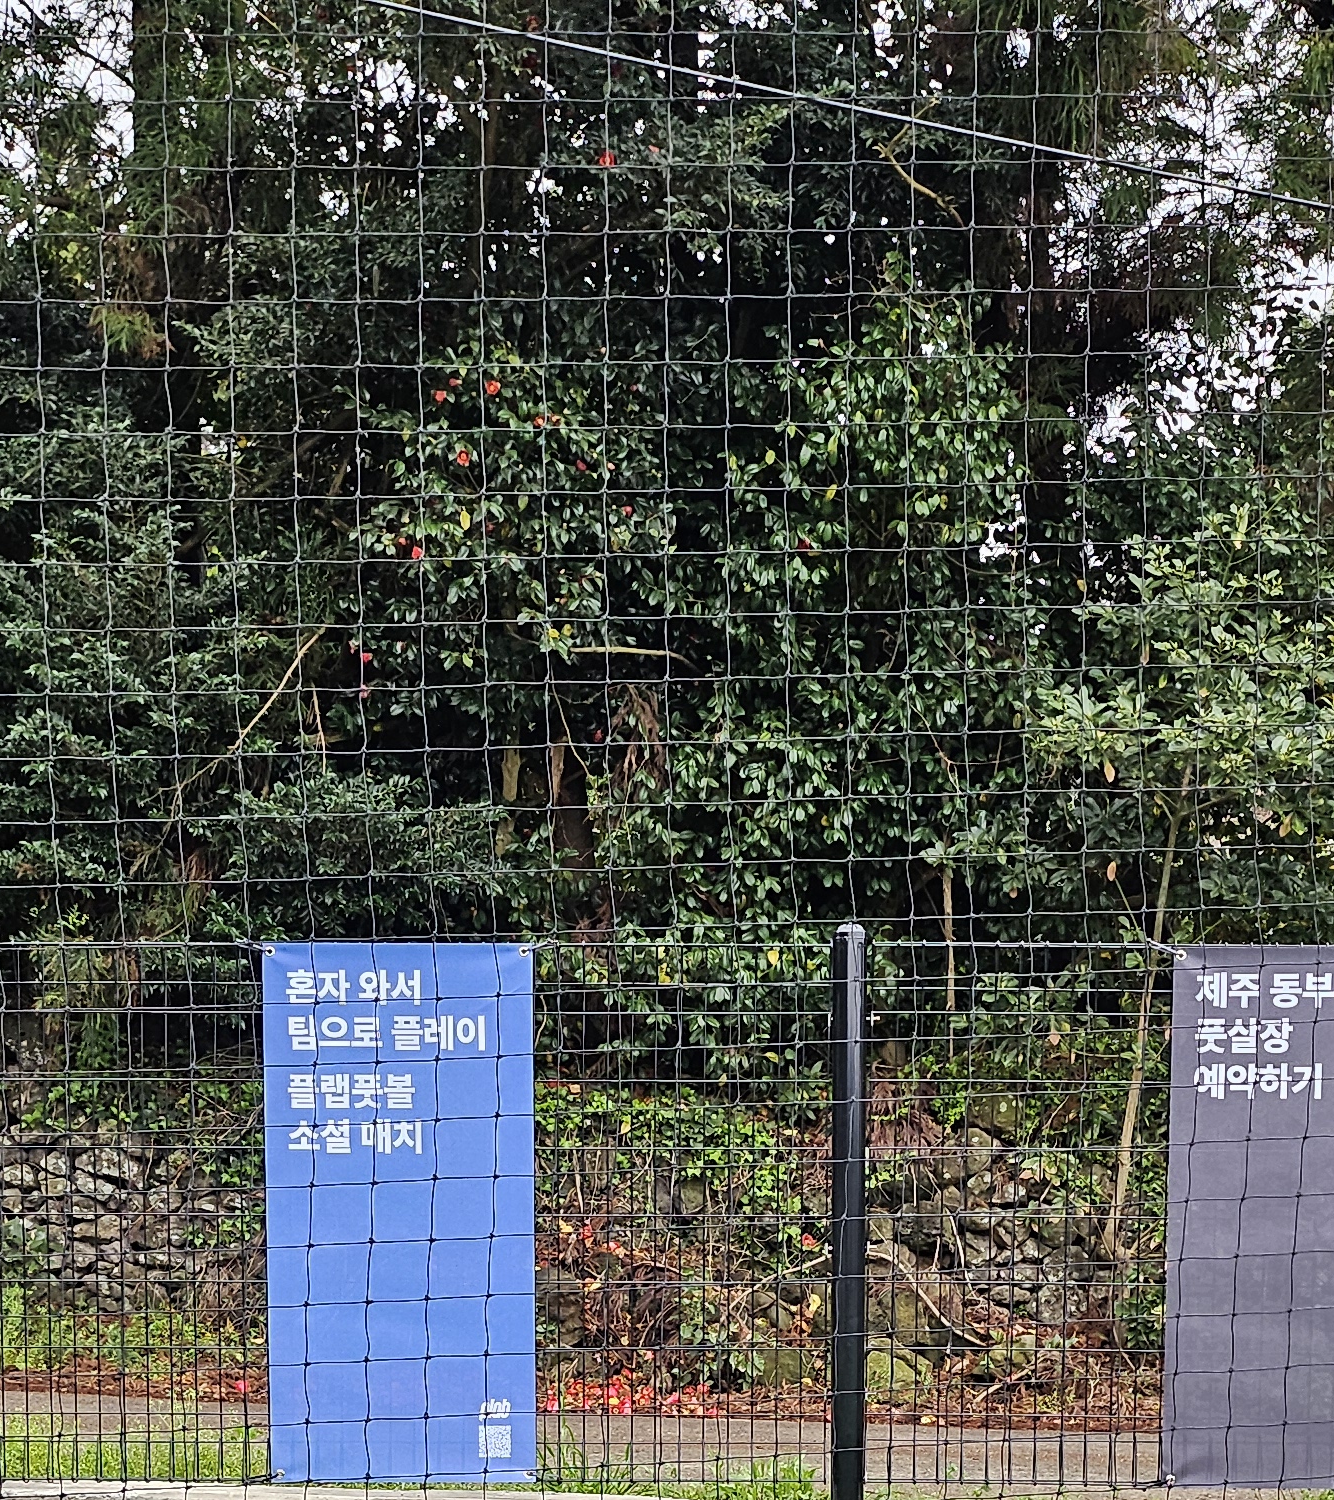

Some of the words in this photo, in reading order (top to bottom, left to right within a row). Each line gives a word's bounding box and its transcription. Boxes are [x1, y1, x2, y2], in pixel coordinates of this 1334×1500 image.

[285, 969, 351, 1006] 혼자
[358, 969, 421, 1006] 와서
[1195, 971, 1260, 1009] 제주
[287, 1014, 383, 1051] 팀으로
[391, 1015, 486, 1051] 플레이
[1194, 1017, 1294, 1054] 풋살장
[287, 1073, 416, 1110] 플랩풋볼
[1193, 1062, 1323, 1100] 예약하기
[287, 1118, 351, 1154] 소셜
[360, 1118, 423, 1154] 매치
